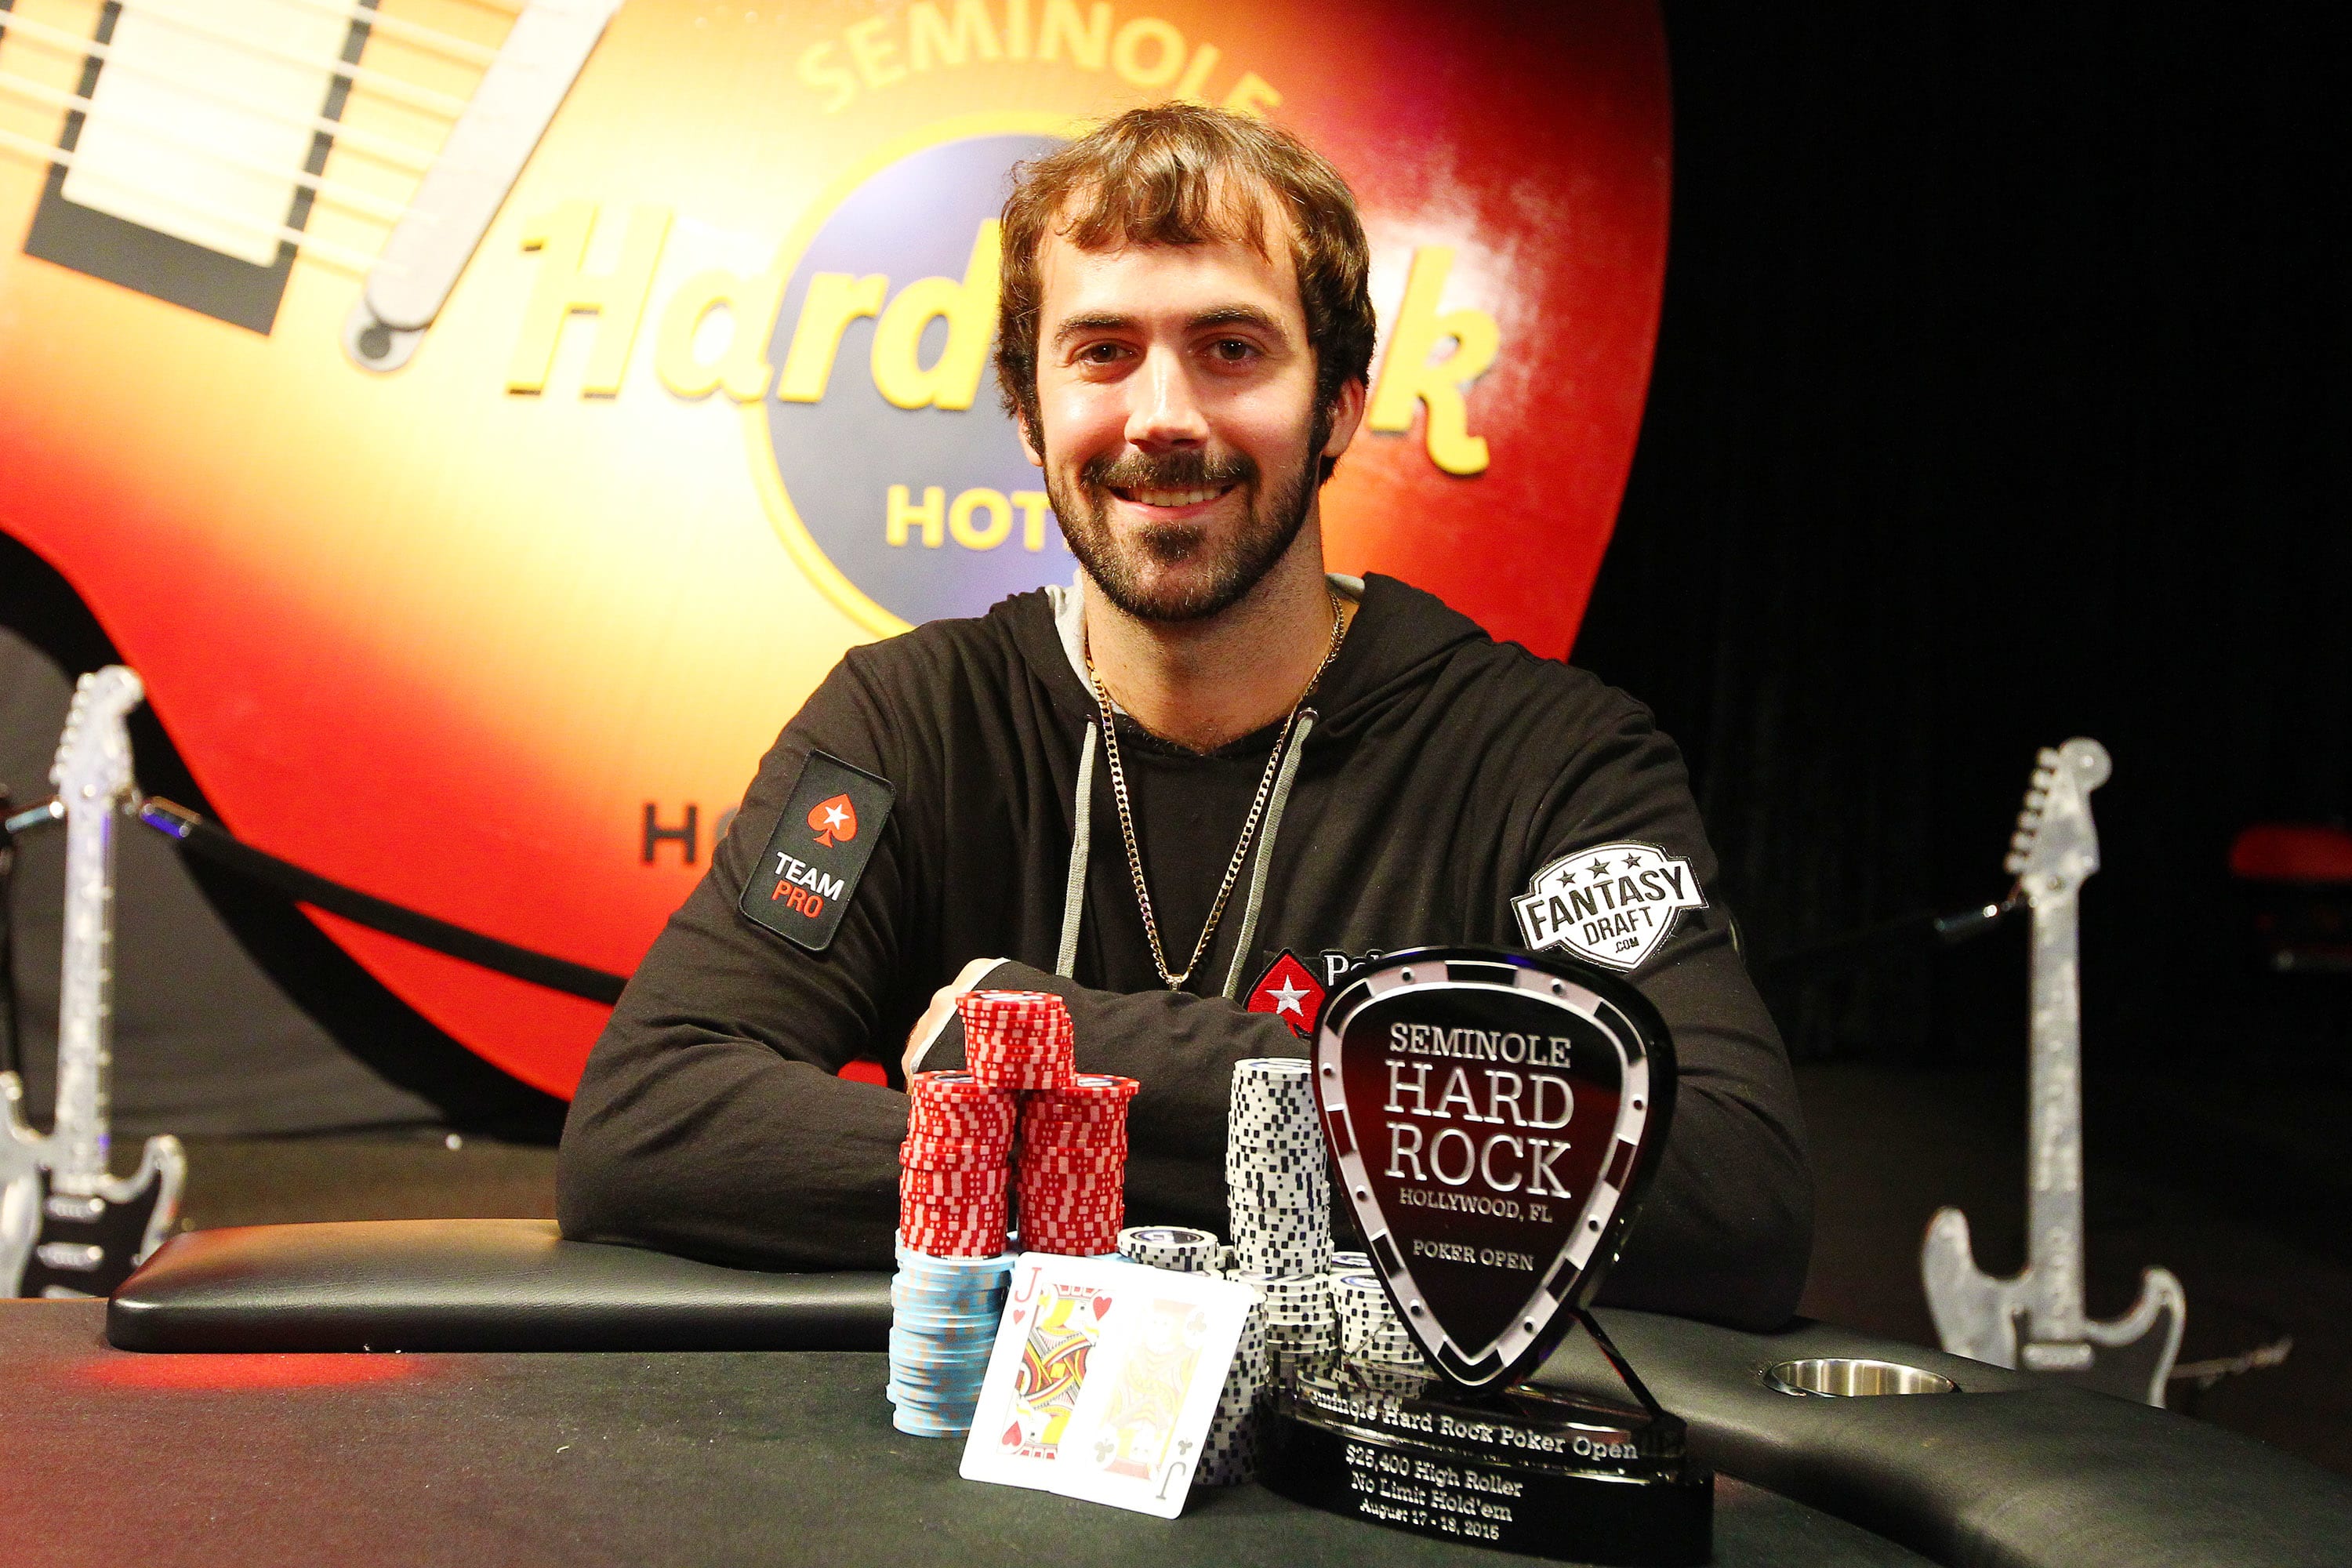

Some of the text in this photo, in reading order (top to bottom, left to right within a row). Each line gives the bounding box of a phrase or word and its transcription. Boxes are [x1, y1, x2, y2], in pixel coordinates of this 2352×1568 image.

[504, 200, 1002, 411] Hard
[886, 484, 1051, 552] HOT
[771, 880, 824, 919] PRO
[775, 851, 844, 902] TEAM
[1526, 866, 1685, 941] FANTASY
[1583, 906, 1653, 946] DRAFT
[1615, 937, 1639, 953] .COM
[1389, 1022, 1571, 1069] SEMINOLE
[1383, 1058, 1574, 1129] HARD
[1385, 1121, 1572, 1199] ROCK
[1399, 1187, 1553, 1223] HOLLYWOOD, FL
[1413, 1238, 1535, 1271] POKER OPEN
[1014, 1266, 1042, 1303] J
[1382, 1400, 1433, 1432] Hard
[1439, 1414, 1494, 1443] Rock
[1499, 1425, 1566, 1454] Poker
[1573, 1435, 1639, 1461] Open
[1351, 1470, 1513, 1522] No Limit Hold'em
[1414, 1460, 1461, 1487] High
[1464, 1469, 1523, 1497] Roller
[1359, 1497, 1408, 1523] August
[1464, 1519, 1500, 1540] 2015
